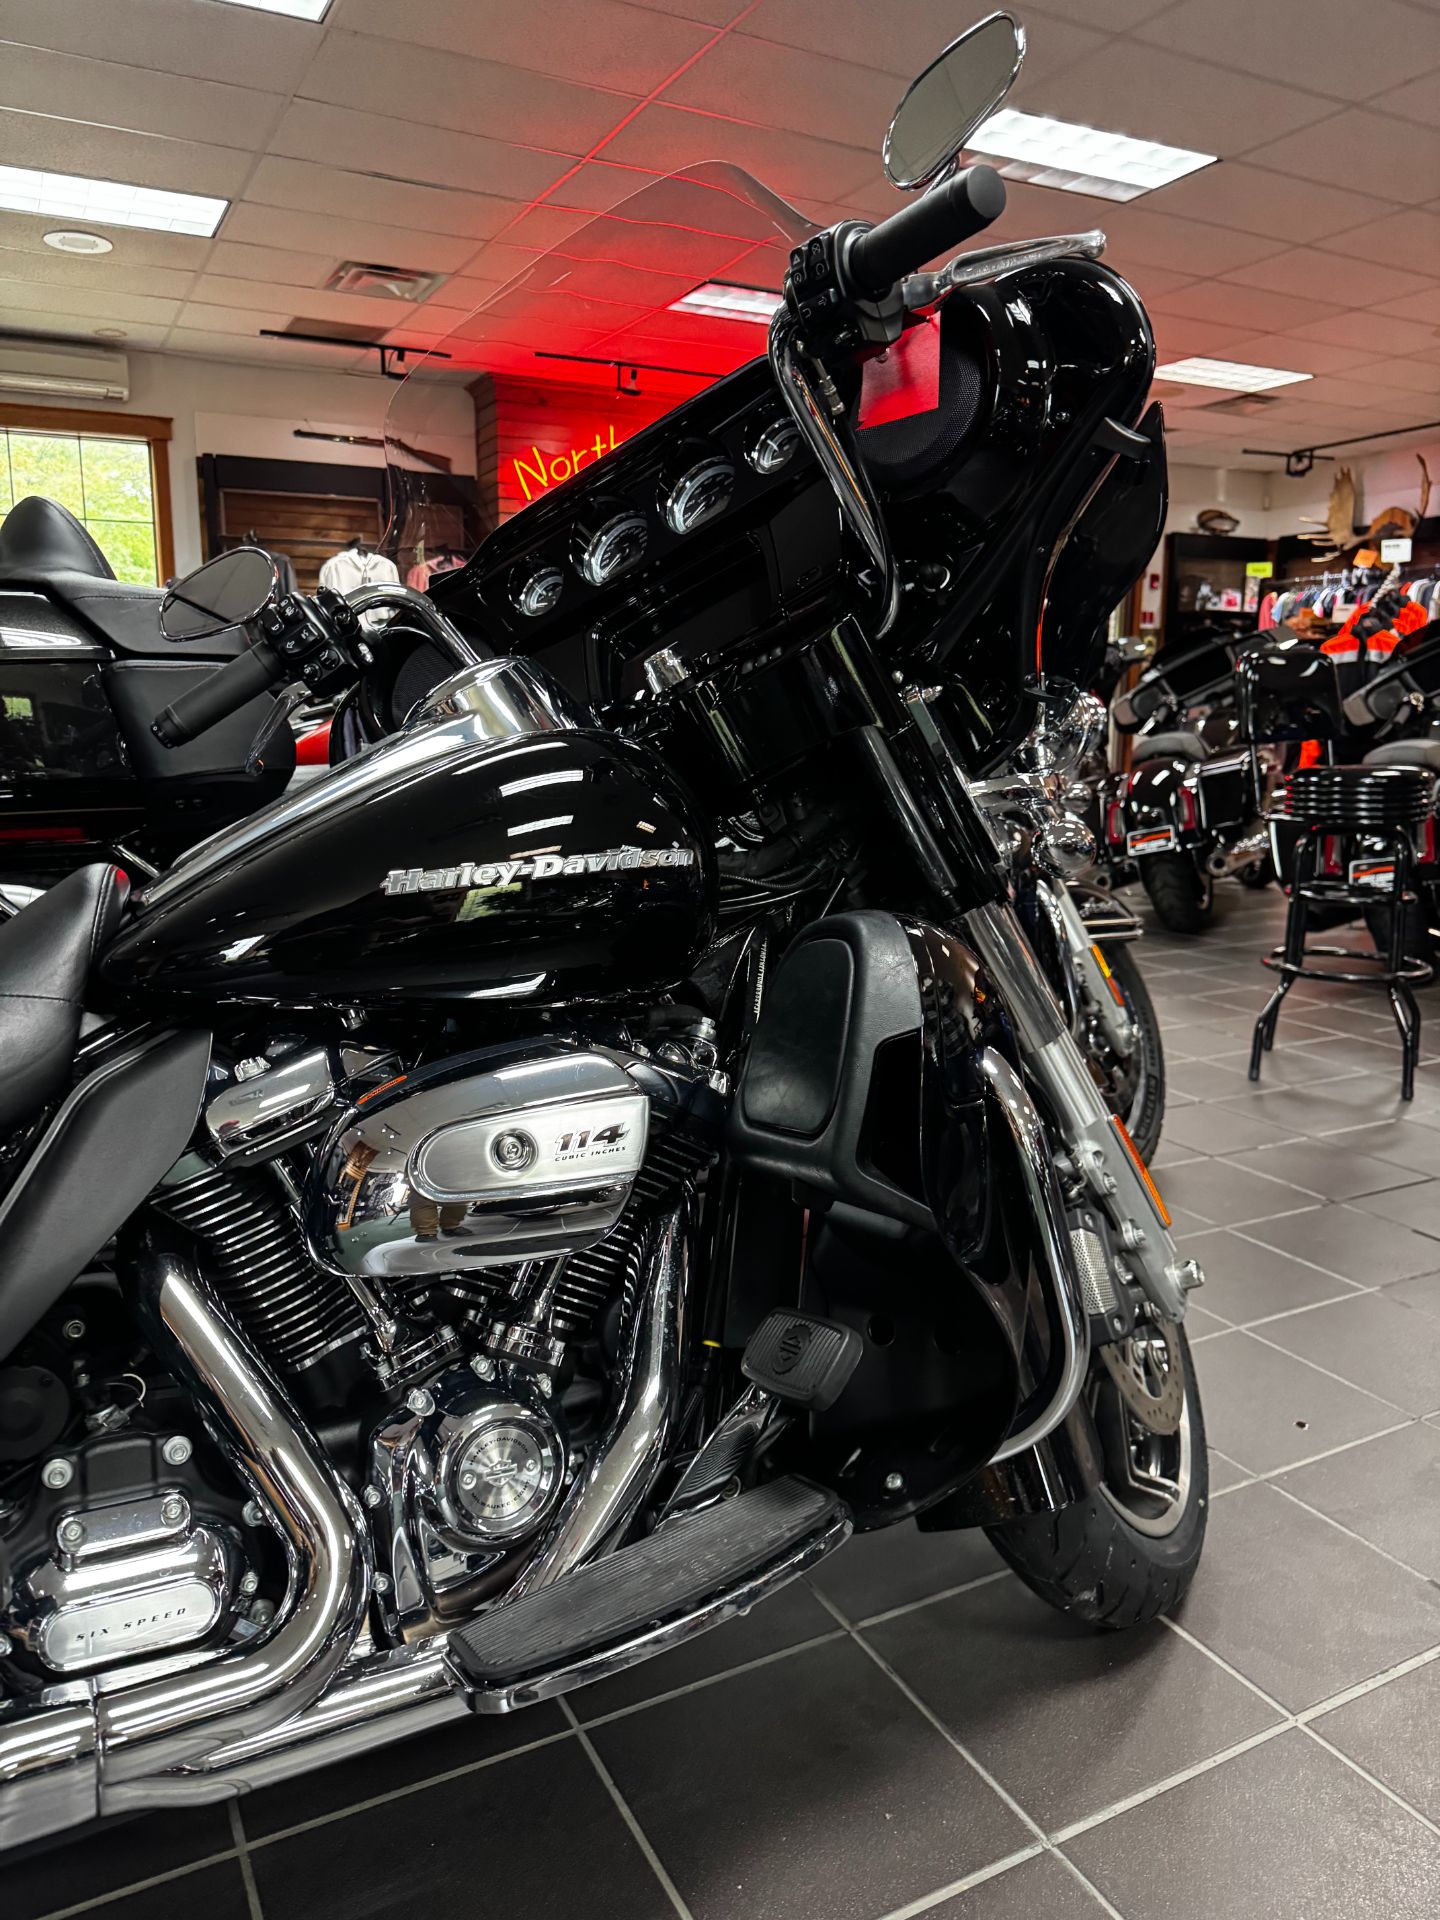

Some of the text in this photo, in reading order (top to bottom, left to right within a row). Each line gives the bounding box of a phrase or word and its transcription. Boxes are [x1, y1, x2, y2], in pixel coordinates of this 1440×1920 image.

[379, 845, 695, 896] Harley-Davidson
[554, 1146, 626, 1162] CUBIC INCHES
[555, 1122, 630, 1155] 114
[75, 1607, 186, 1642] SIX SPEED
